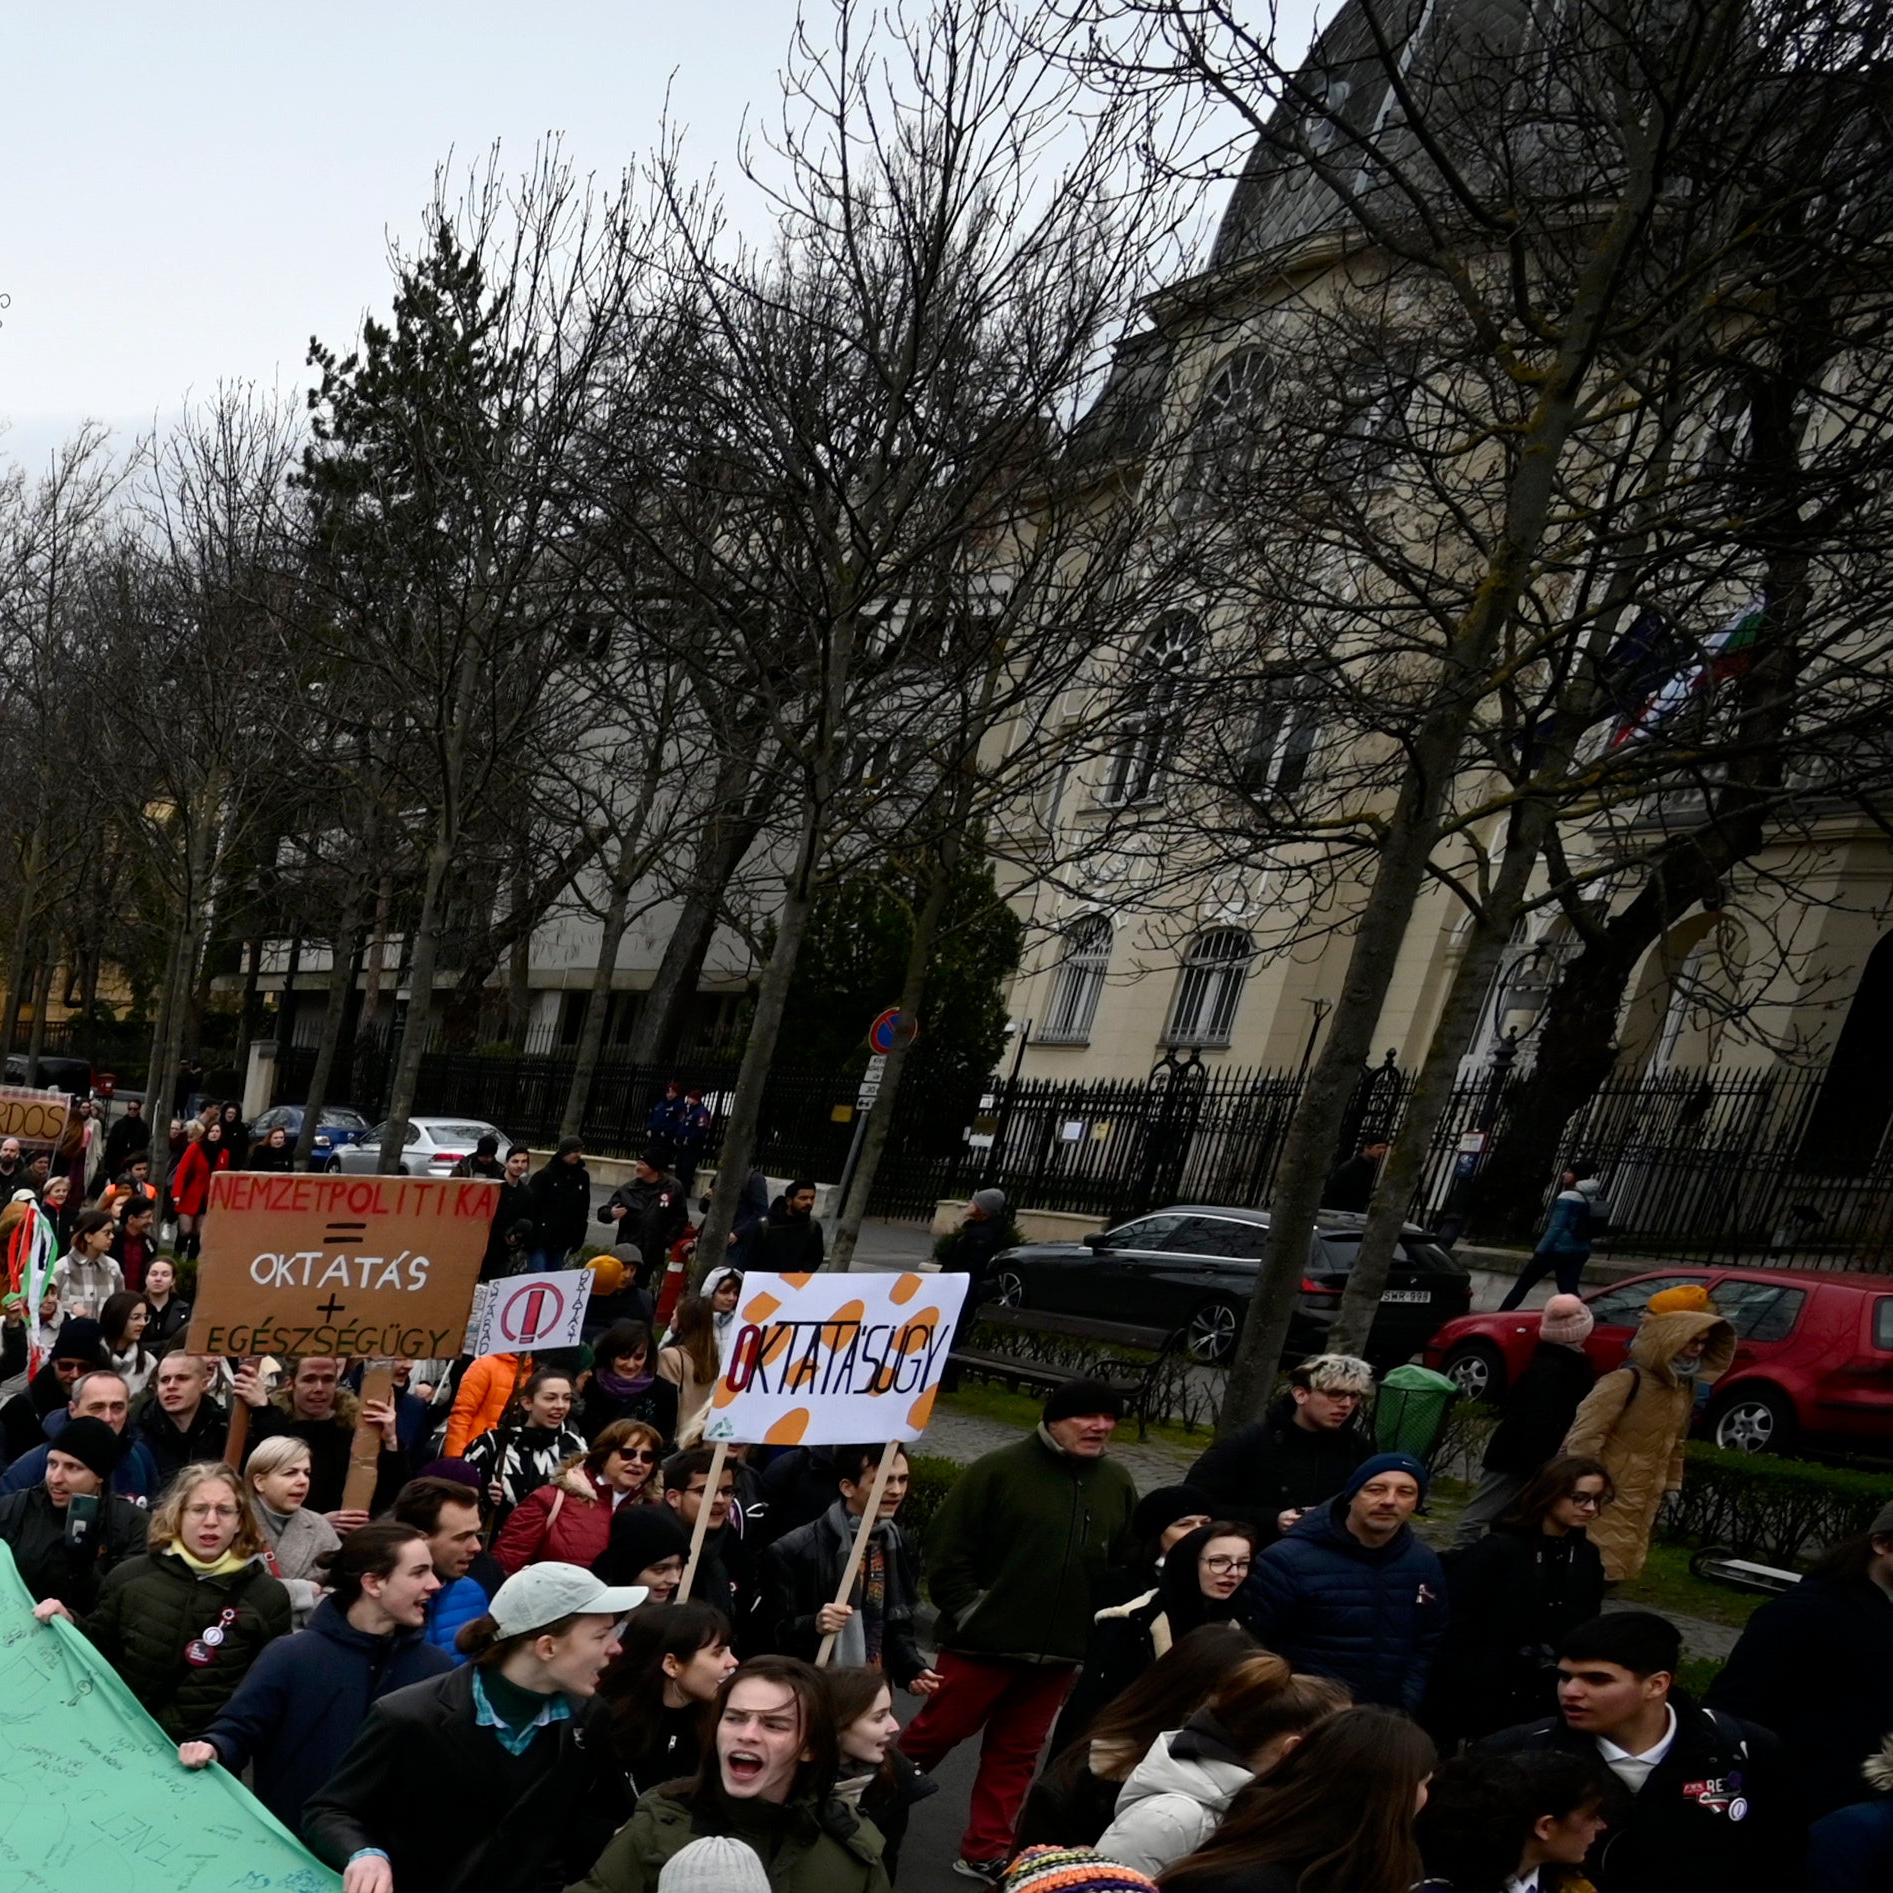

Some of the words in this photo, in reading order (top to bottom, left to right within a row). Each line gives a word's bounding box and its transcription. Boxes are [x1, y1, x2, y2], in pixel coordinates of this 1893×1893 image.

[210, 1176, 494, 1218] NEMZETPOLITIKA
[250, 1251, 431, 1291] OKTATÁS
[206, 1316, 451, 1357] EGÉSZSÉGÜGY
